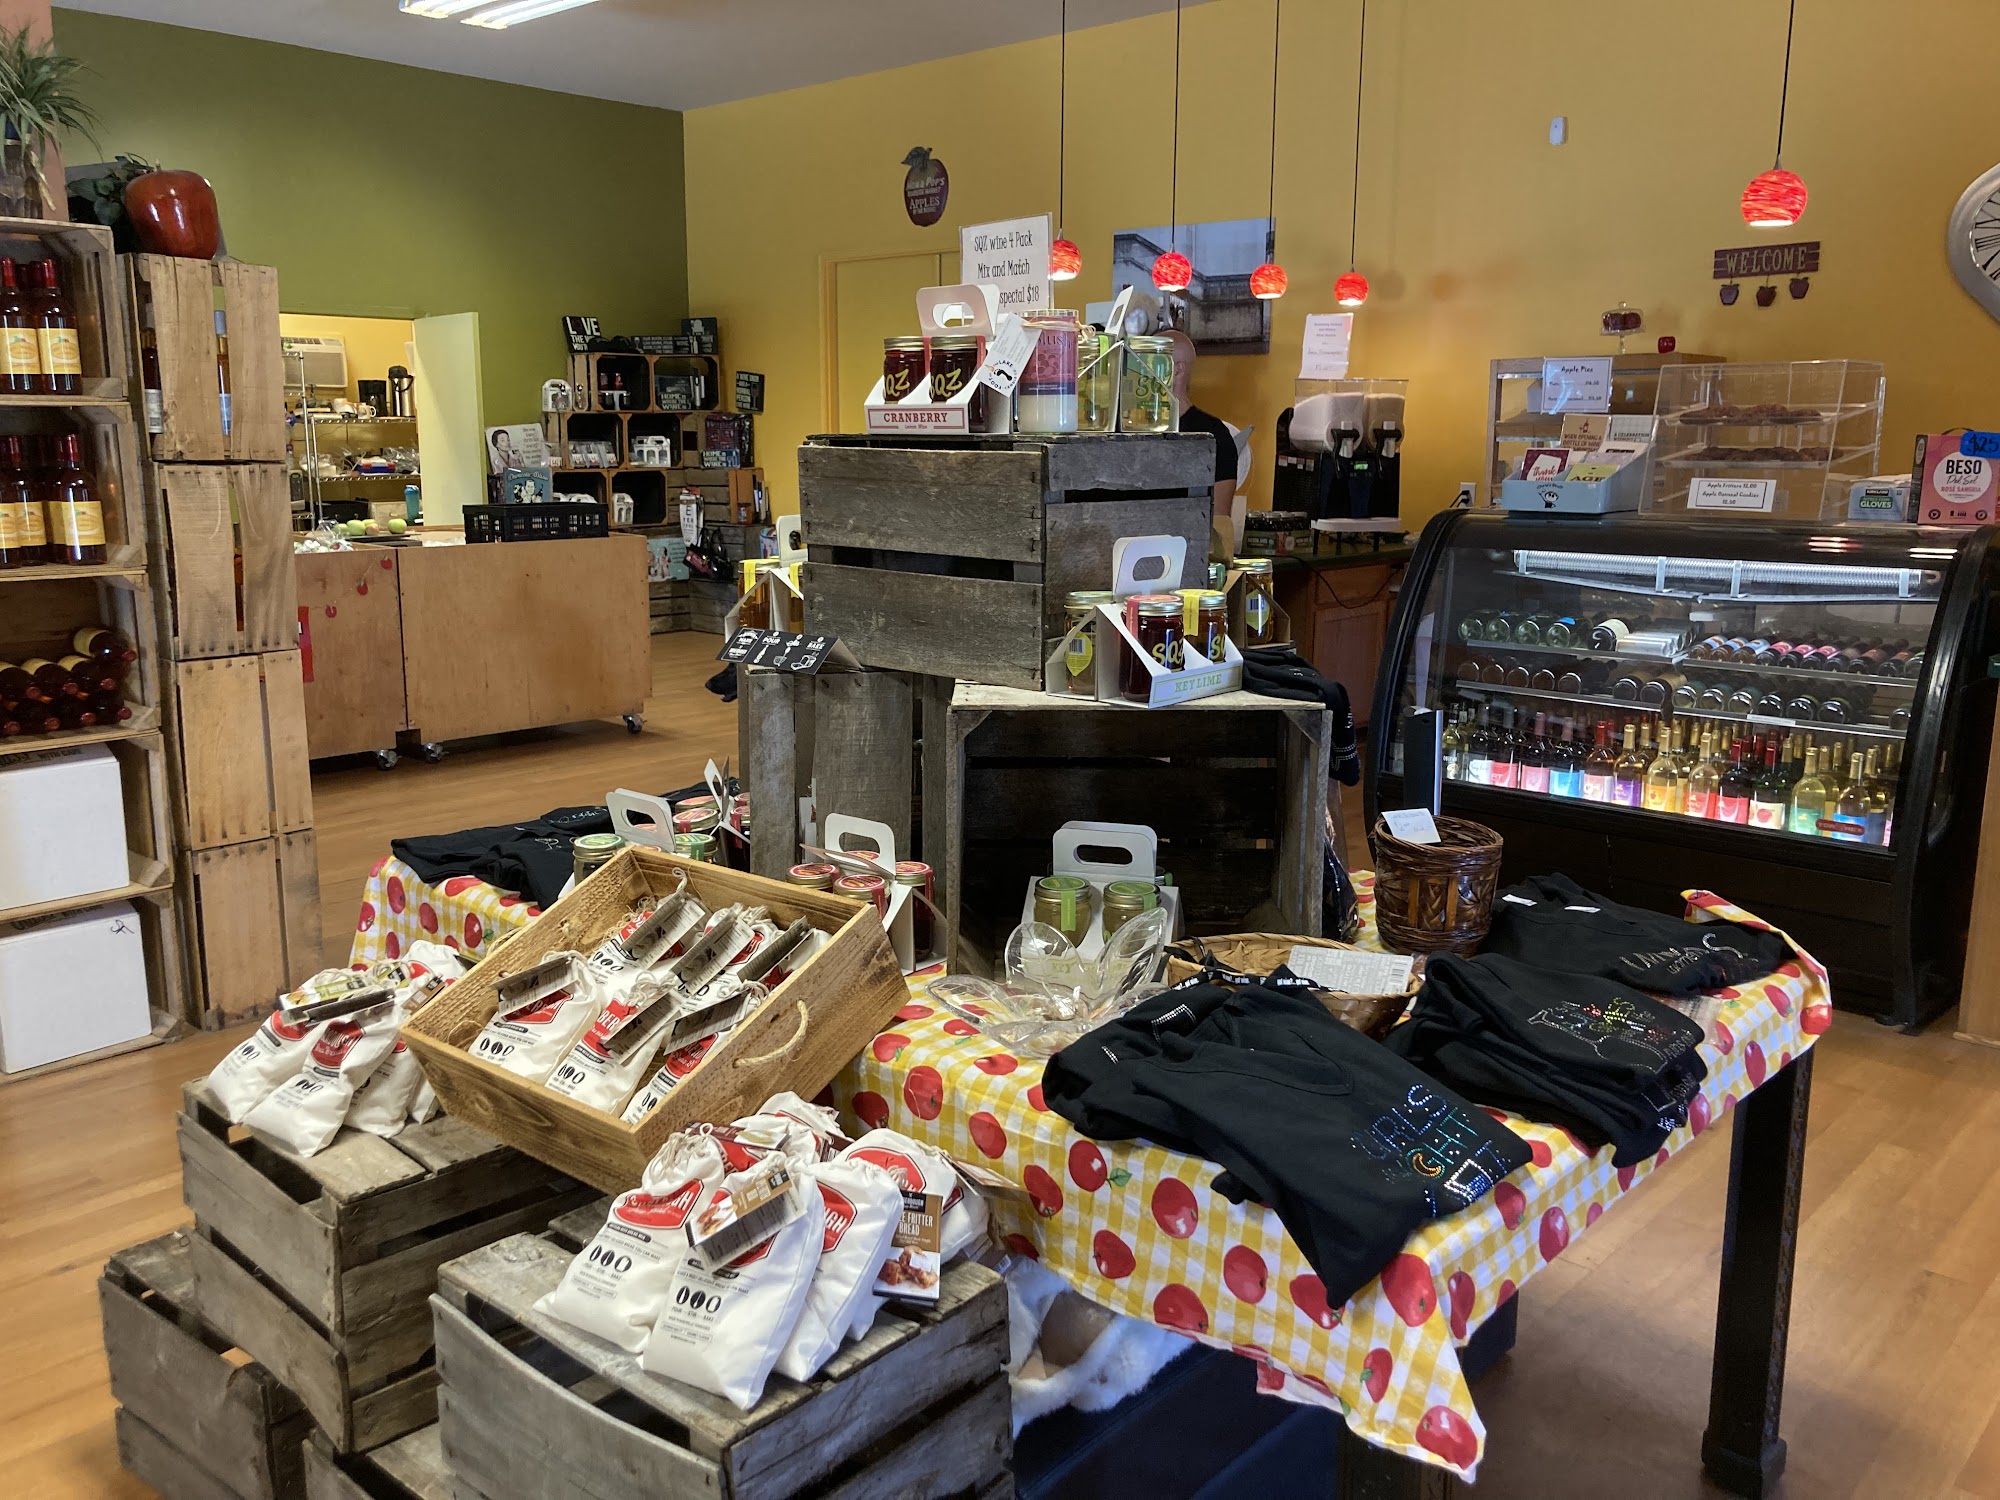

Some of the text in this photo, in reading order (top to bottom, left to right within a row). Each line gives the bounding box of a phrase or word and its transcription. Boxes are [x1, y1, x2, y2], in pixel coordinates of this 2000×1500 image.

[910, 196, 940, 209] APPLES
[974, 230, 1033, 253] SQZ wine 4 Pack
[1726, 246, 1808, 274] WELCOME
[977, 259, 1030, 279] Mix and Match
[999, 283, 1039, 308] special $18
[571, 335, 585, 343] THE
[1561, 365, 1579, 374] Apple
[883, 368, 910, 399] QZ
[883, 412, 948, 423] CRANBERRY
[1968, 433, 1999, 456] $25
[1532, 465, 1557, 477] thank
[1945, 459, 1983, 475] BESO
[1946, 475, 1978, 485] Del Sol
[1941, 485, 1955, 493] ROSÉ
[1860, 500, 1892, 509] GLOVES
[762, 637, 781, 646] POUR
[806, 642, 825, 650] BAKE
[1175, 674, 1222, 693] KEY LIME
[907, 1211, 934, 1228] FRITTER
[899, 1221, 920, 1236] BREAD
